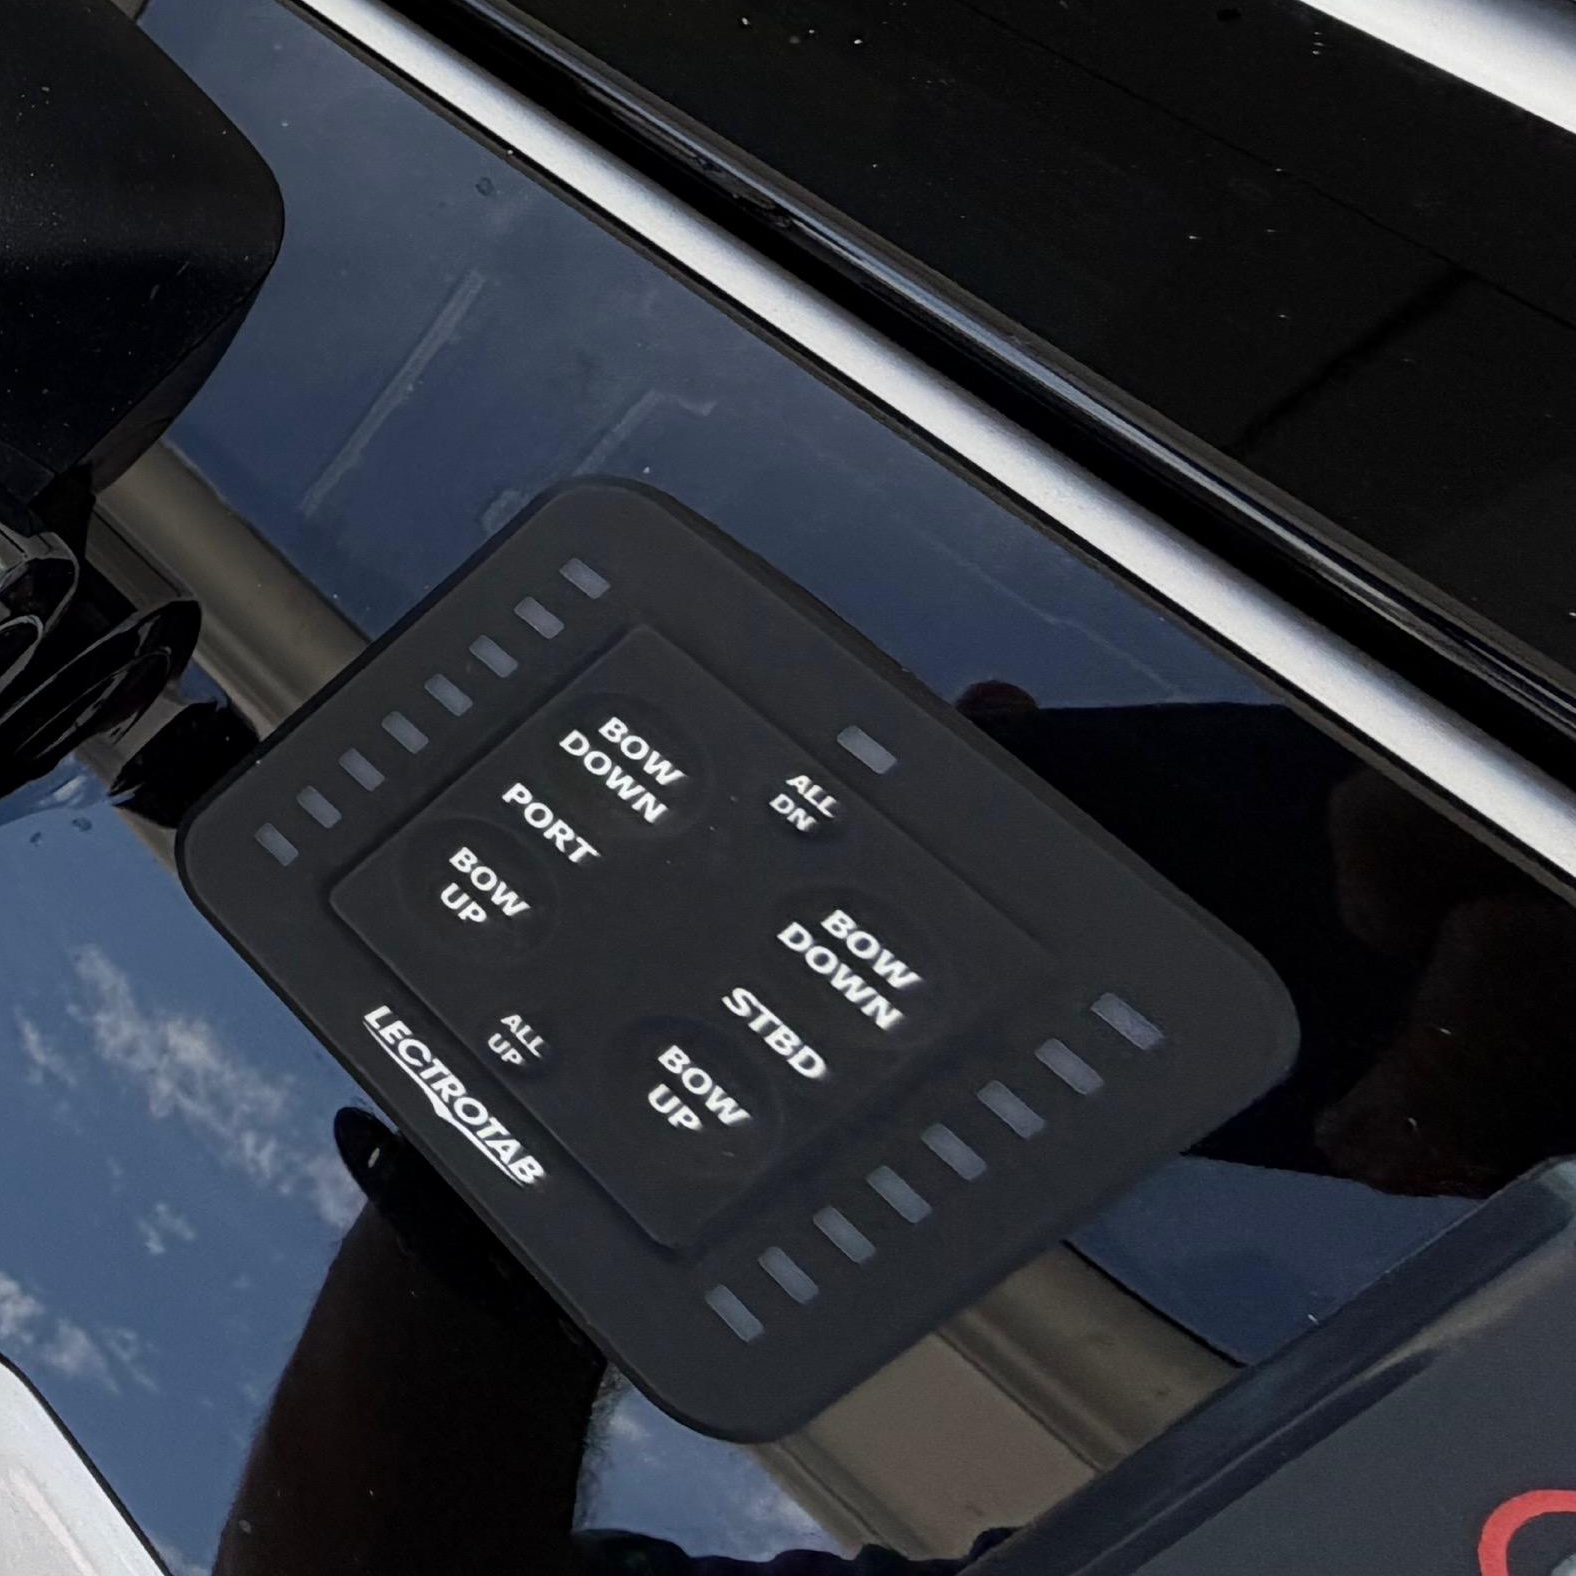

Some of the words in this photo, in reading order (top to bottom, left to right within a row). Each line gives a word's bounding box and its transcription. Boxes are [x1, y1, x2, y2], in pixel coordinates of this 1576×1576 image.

[558, 729, 671, 824] DOWN
[598, 716, 688, 787] BOW
[501, 782, 603, 864] PORT
[769, 792, 817, 833] DN
[786, 774, 841, 818] ALL
[439, 882, 488, 925] UP
[448, 846, 532, 918] BOW
[775, 921, 907, 1031] DOWN
[819, 908, 925, 991] BOW
[486, 1031, 527, 1067] UP
[500, 1012, 550, 1060] ALL
[721, 986, 830, 1081] STBD
[362, 1004, 549, 1190] LECTROTAB
[646, 1082, 705, 1133] UP
[656, 1044, 755, 1126] BOW
